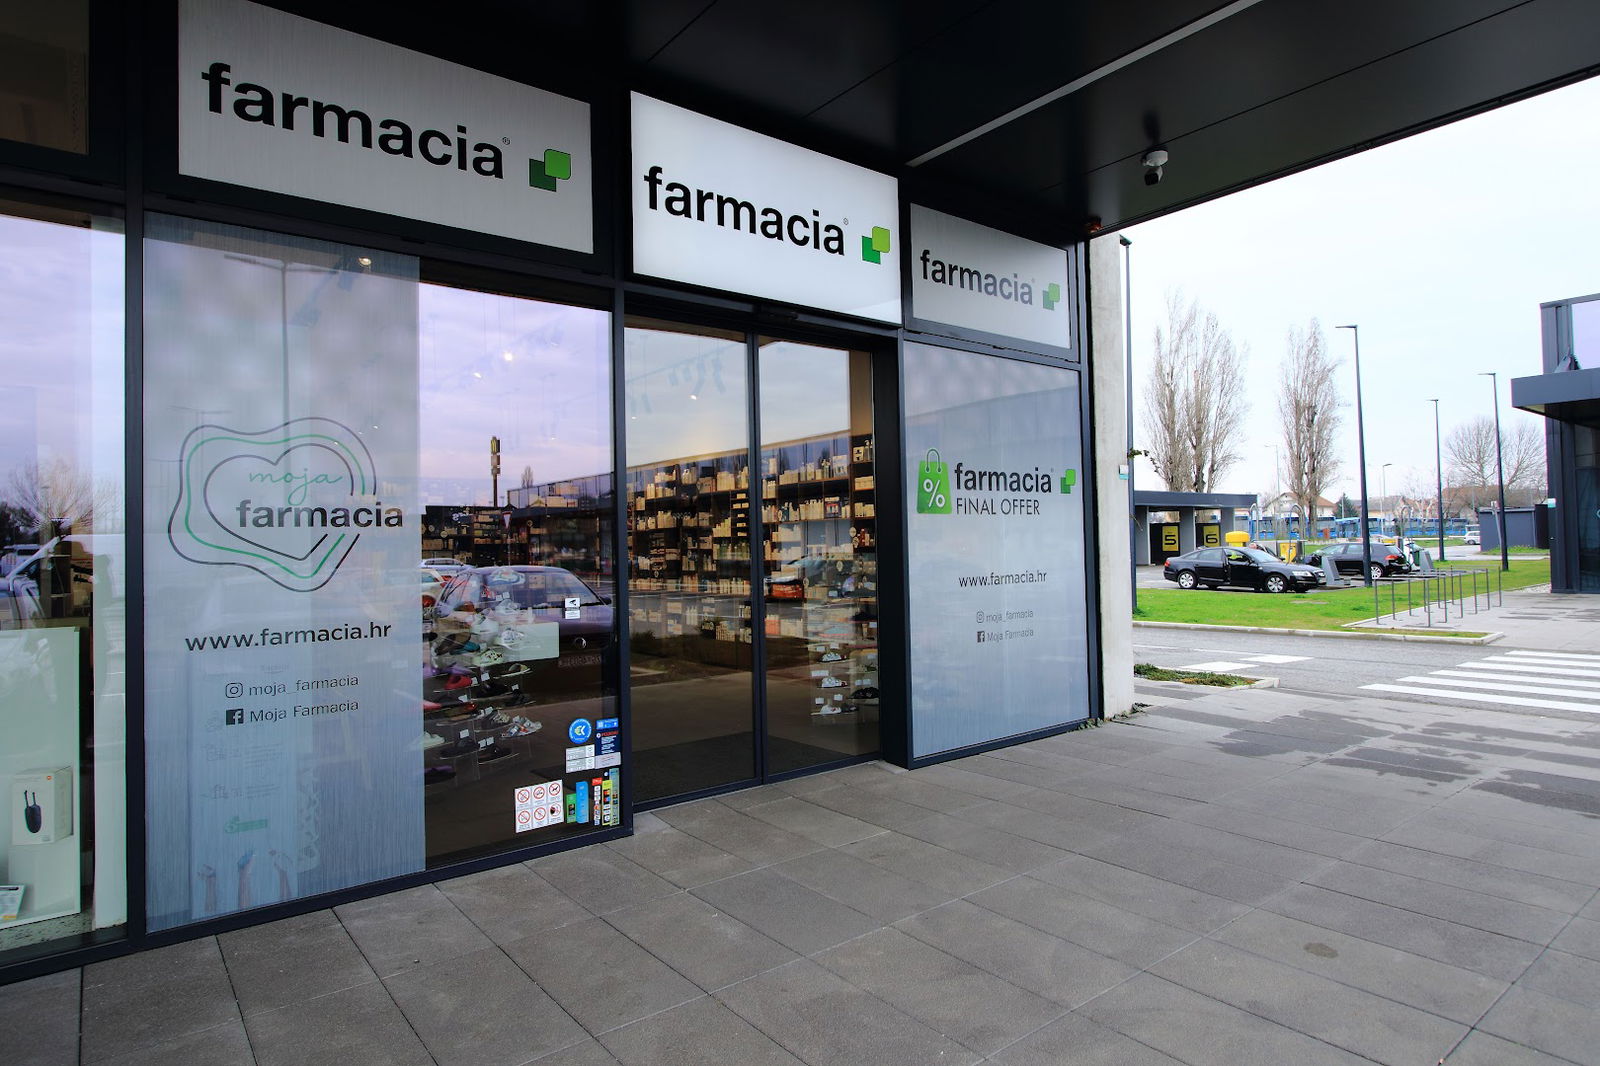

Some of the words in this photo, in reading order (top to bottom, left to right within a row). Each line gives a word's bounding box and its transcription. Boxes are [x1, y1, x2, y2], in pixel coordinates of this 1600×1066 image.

[201, 62, 504, 180] farmacia
[643, 165, 845, 256] farmacia
[920, 249, 1033, 305] farmacia
[249, 468, 343, 506] moja
[954, 463, 1052, 493] farmacia
[236, 500, 403, 528] farmacia
[956, 497, 996, 515] FINAL
[1000, 498, 1040, 515] OFFER
[1165, 535, 1176, 545] 5
[1206, 534, 1217, 543] 6
[959, 570, 1048, 588] www.farmacia.hr
[185, 622, 392, 651] www.farmacia.hr
[987, 631, 1003, 642] Moja
[249, 675, 359, 697] moja_farmacia
[250, 709, 287, 723] Moja
[293, 700, 360, 718] Farmacia
